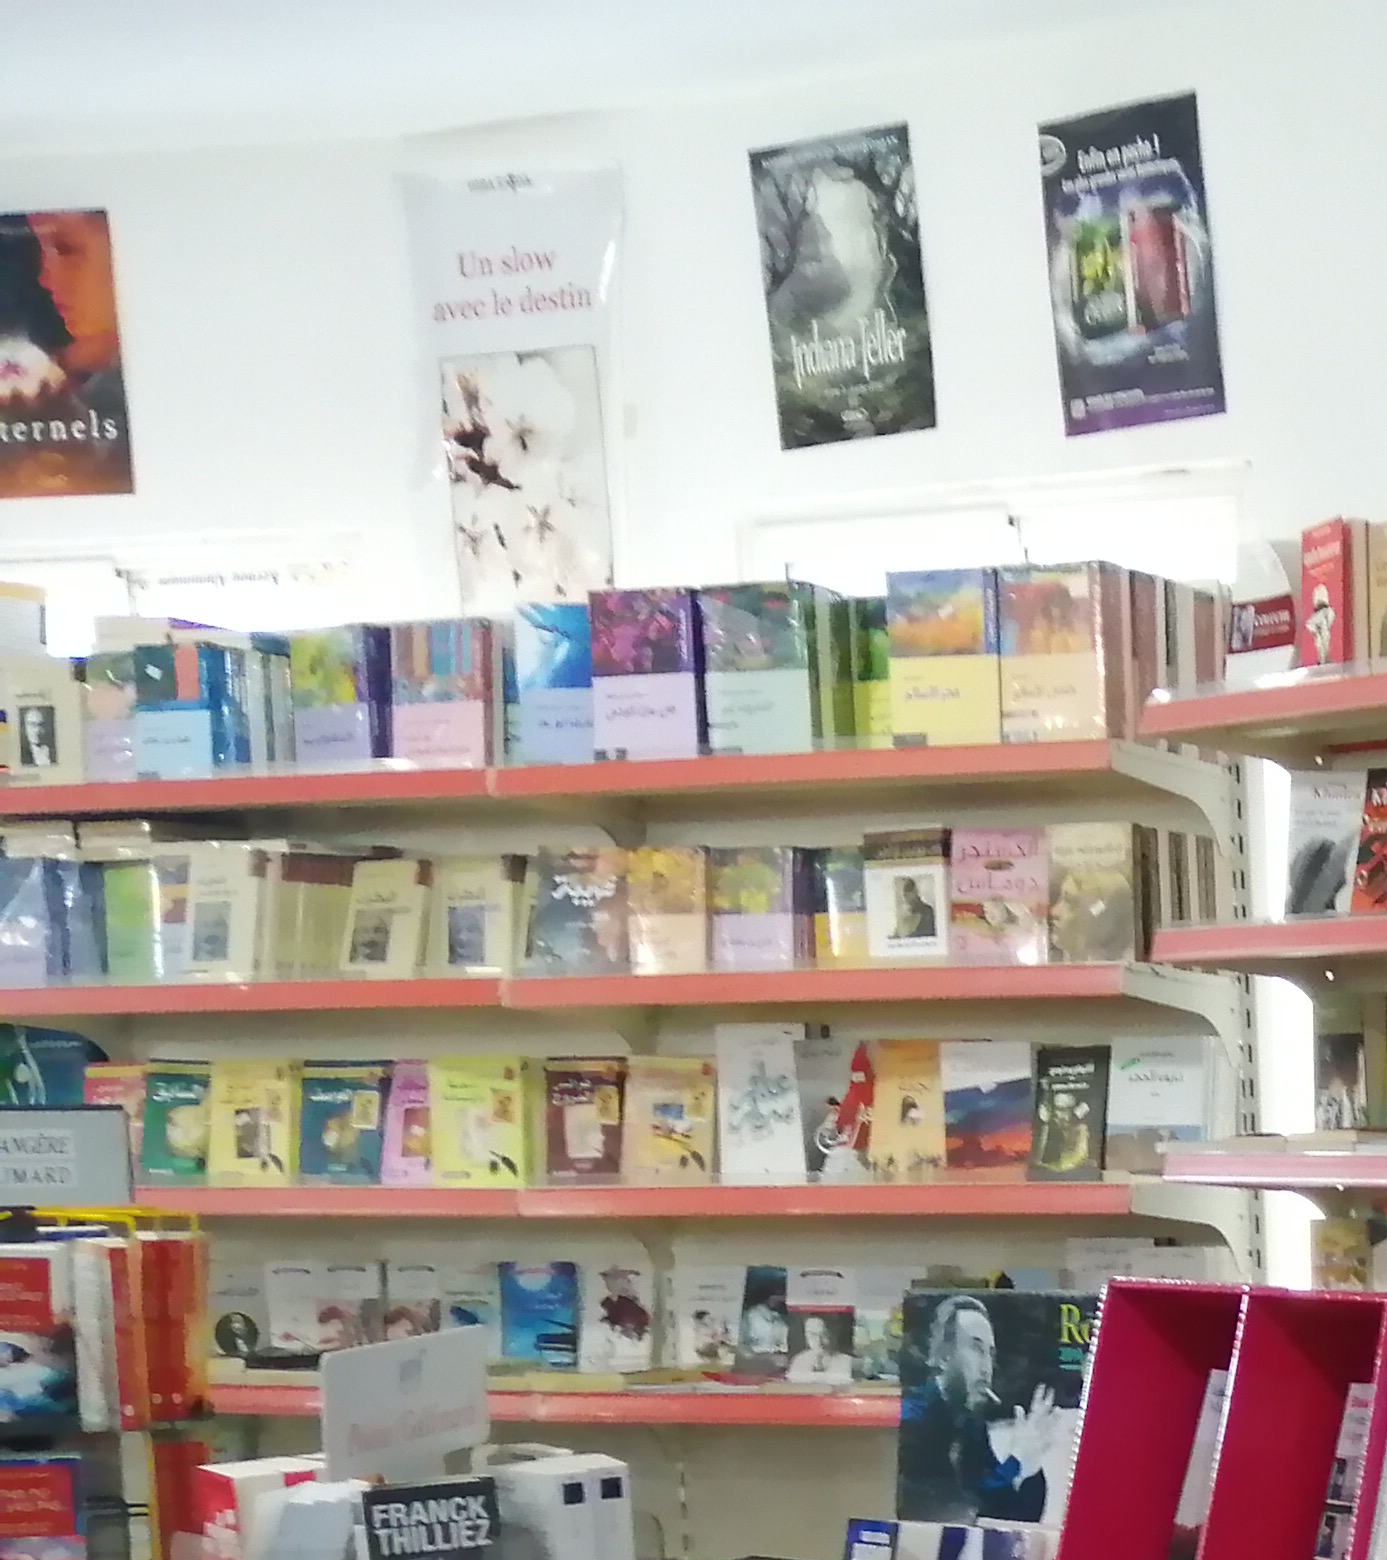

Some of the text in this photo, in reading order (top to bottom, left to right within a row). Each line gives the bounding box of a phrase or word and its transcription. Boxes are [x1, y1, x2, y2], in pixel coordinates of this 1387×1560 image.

[457, 245, 554, 278] Un slow
[432, 279, 593, 323] avec le destin
[791, 307, 907, 390] Indiana Teller
[372, 1495, 489, 1529] FRANCK
[375, 1519, 493, 1557] THILLIEZ
